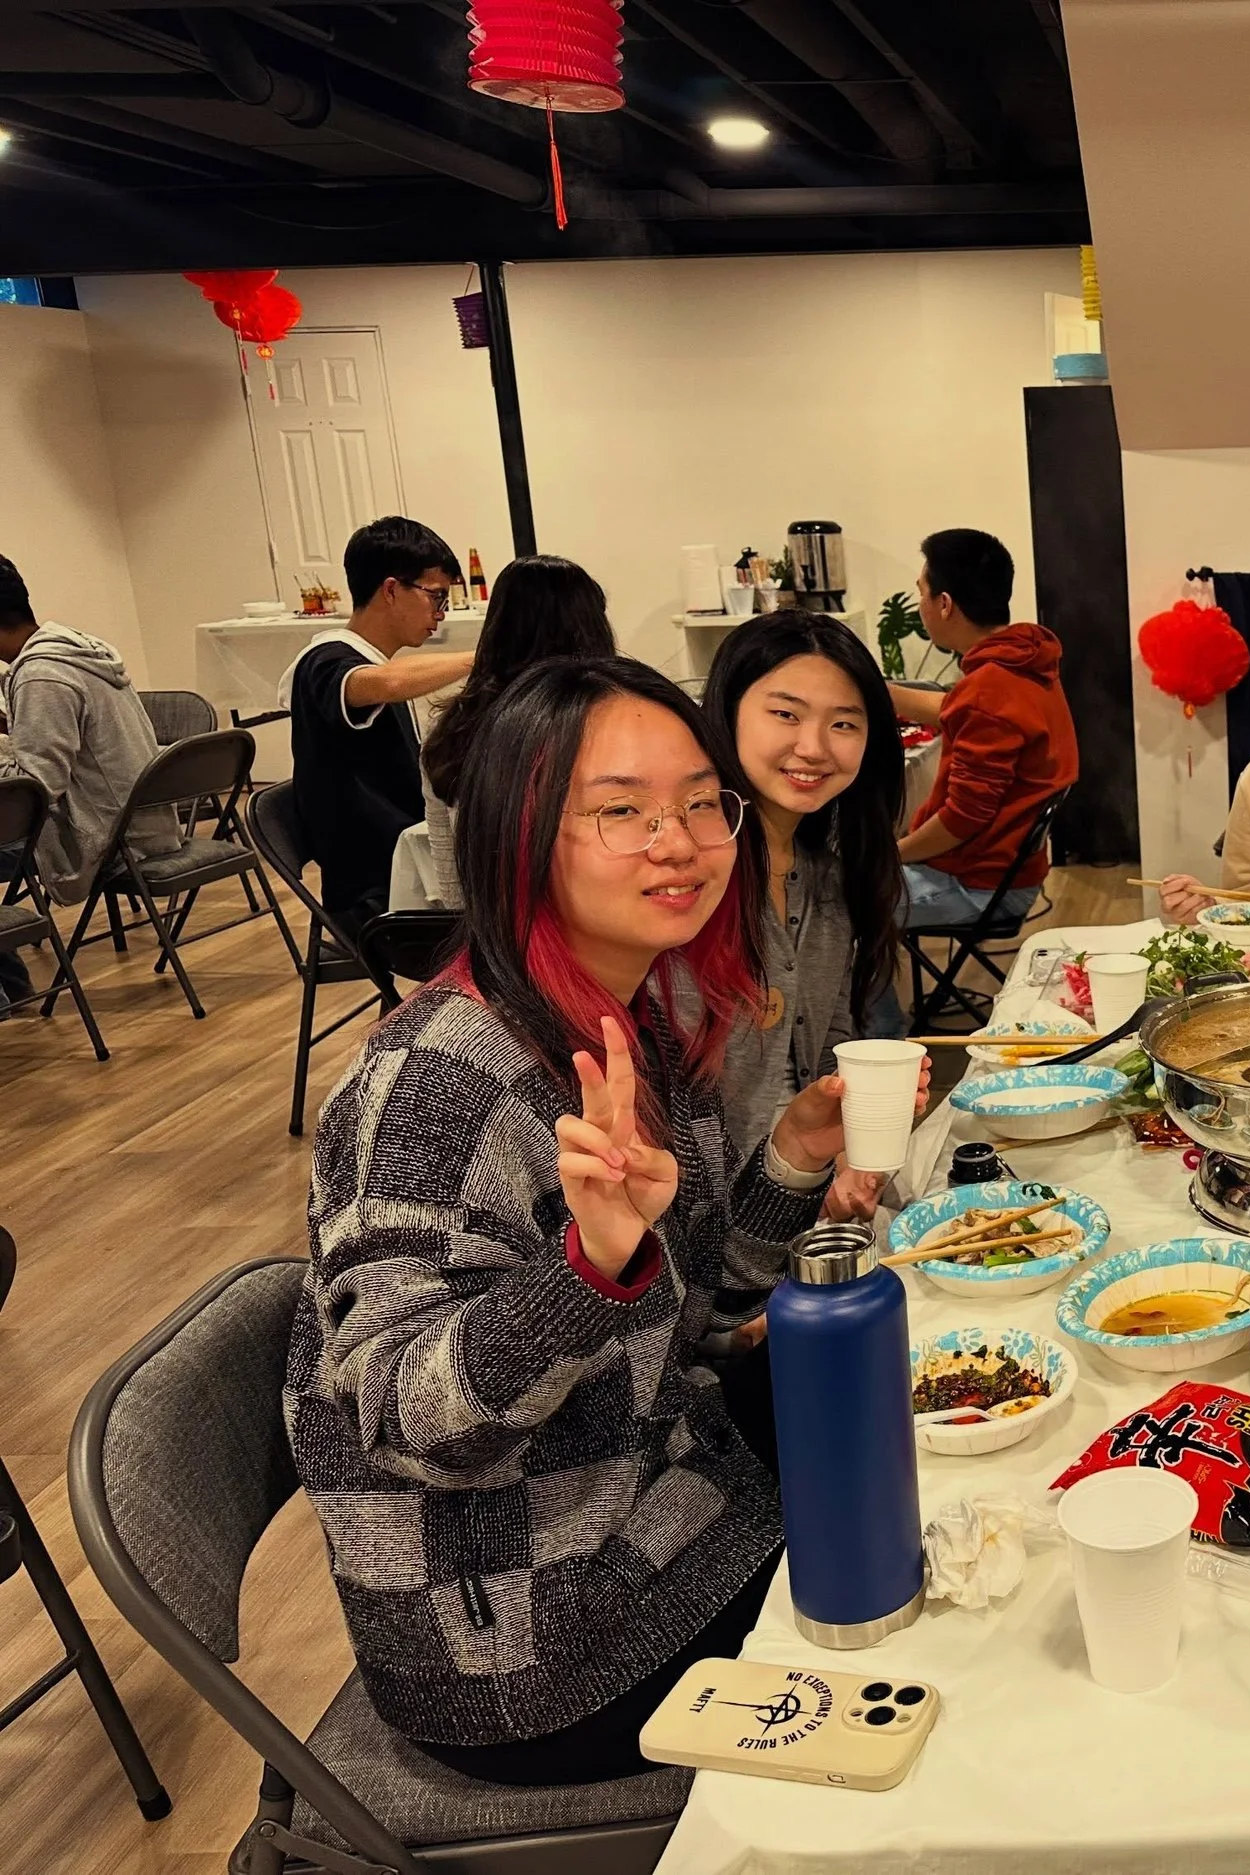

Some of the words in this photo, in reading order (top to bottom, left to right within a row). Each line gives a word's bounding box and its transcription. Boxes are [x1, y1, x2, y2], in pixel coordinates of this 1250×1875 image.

[786, 1671, 803, 1682] NO
[689, 1687, 717, 1713] MAFTY
[803, 1674, 833, 1718] EXCEPTIONS
[804, 1720, 823, 1731] TO
[737, 1737, 777, 1750] RULES
[782, 1729, 807, 1746] THE
